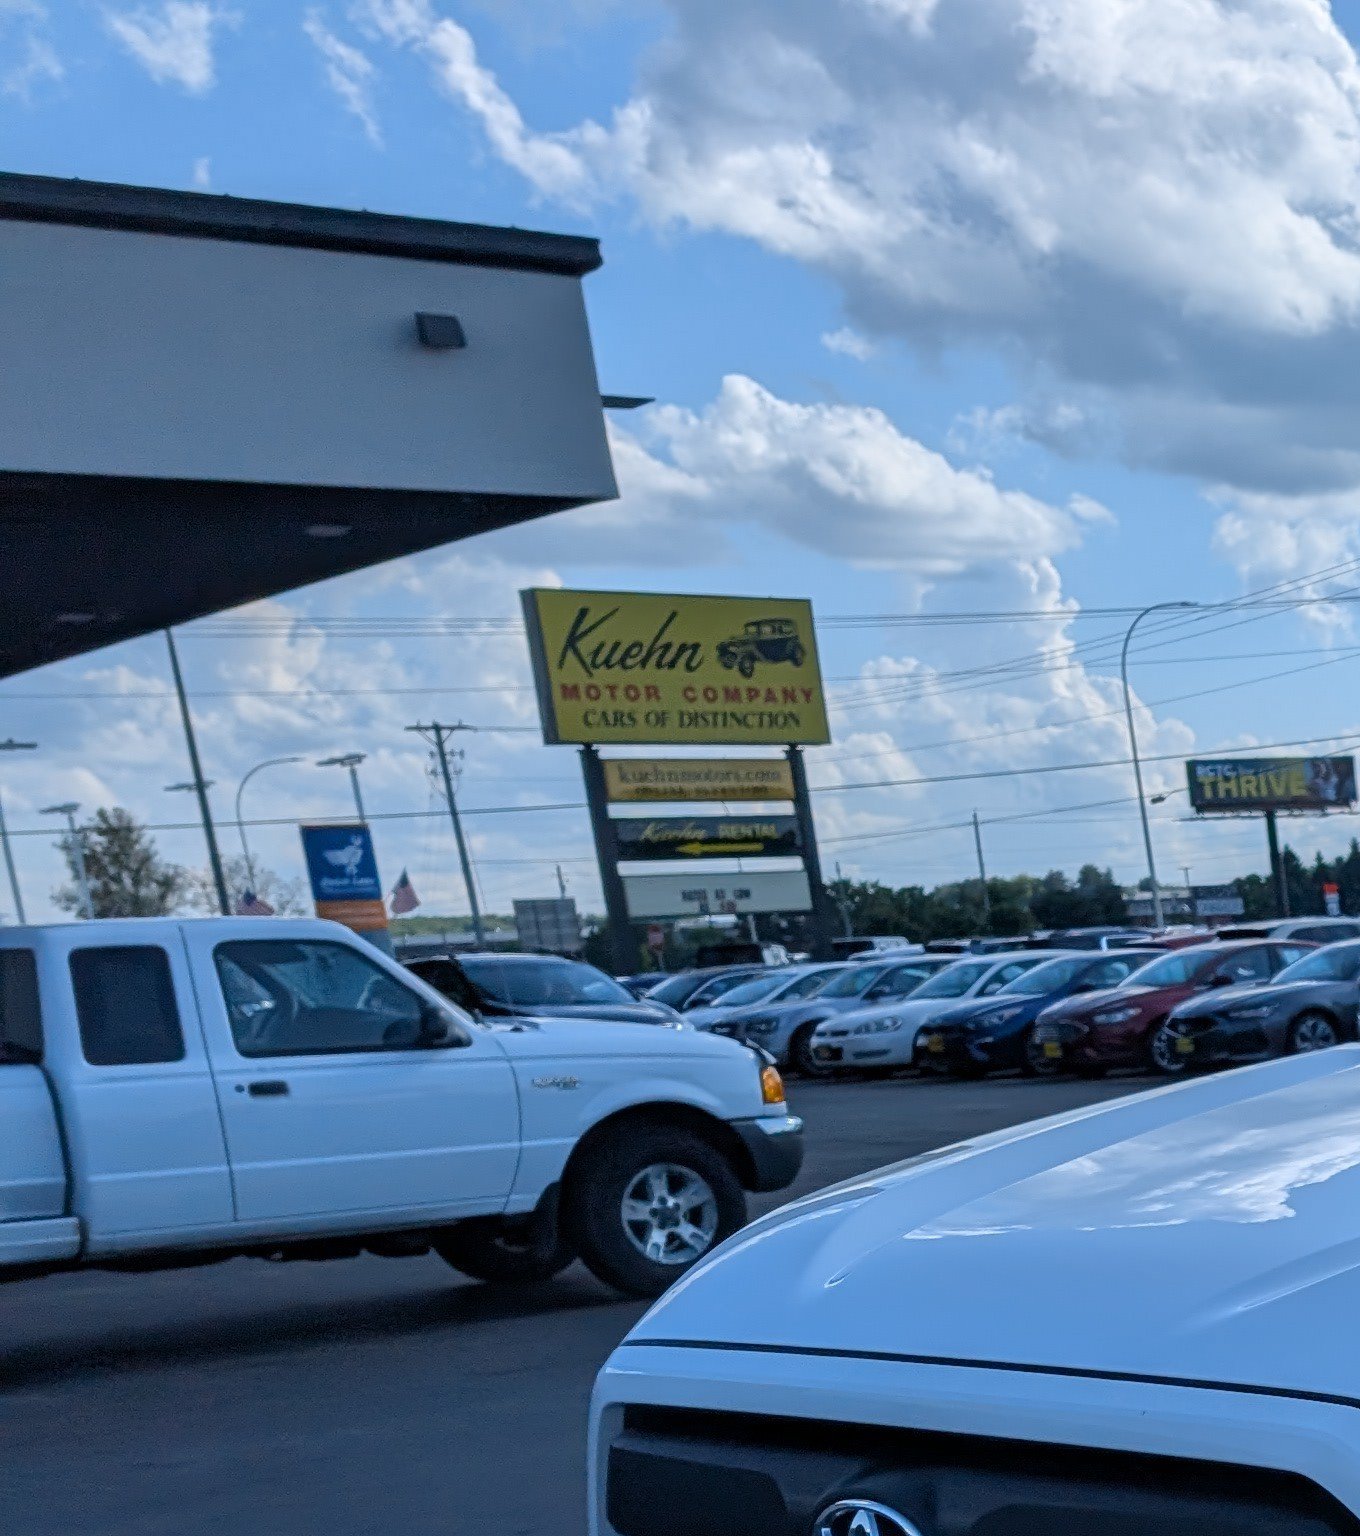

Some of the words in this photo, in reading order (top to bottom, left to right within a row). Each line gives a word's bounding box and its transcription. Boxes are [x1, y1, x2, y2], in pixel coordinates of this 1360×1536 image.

[557, 607, 703, 678] Kuehn
[560, 684, 661, 702] MOTOR
[682, 686, 814, 704] COMPANY
[583, 709, 637, 728] CARS
[644, 710, 671, 728] OF
[679, 710, 801, 729] DISTINCTION
[1197, 773, 1307, 799] THRIVE
